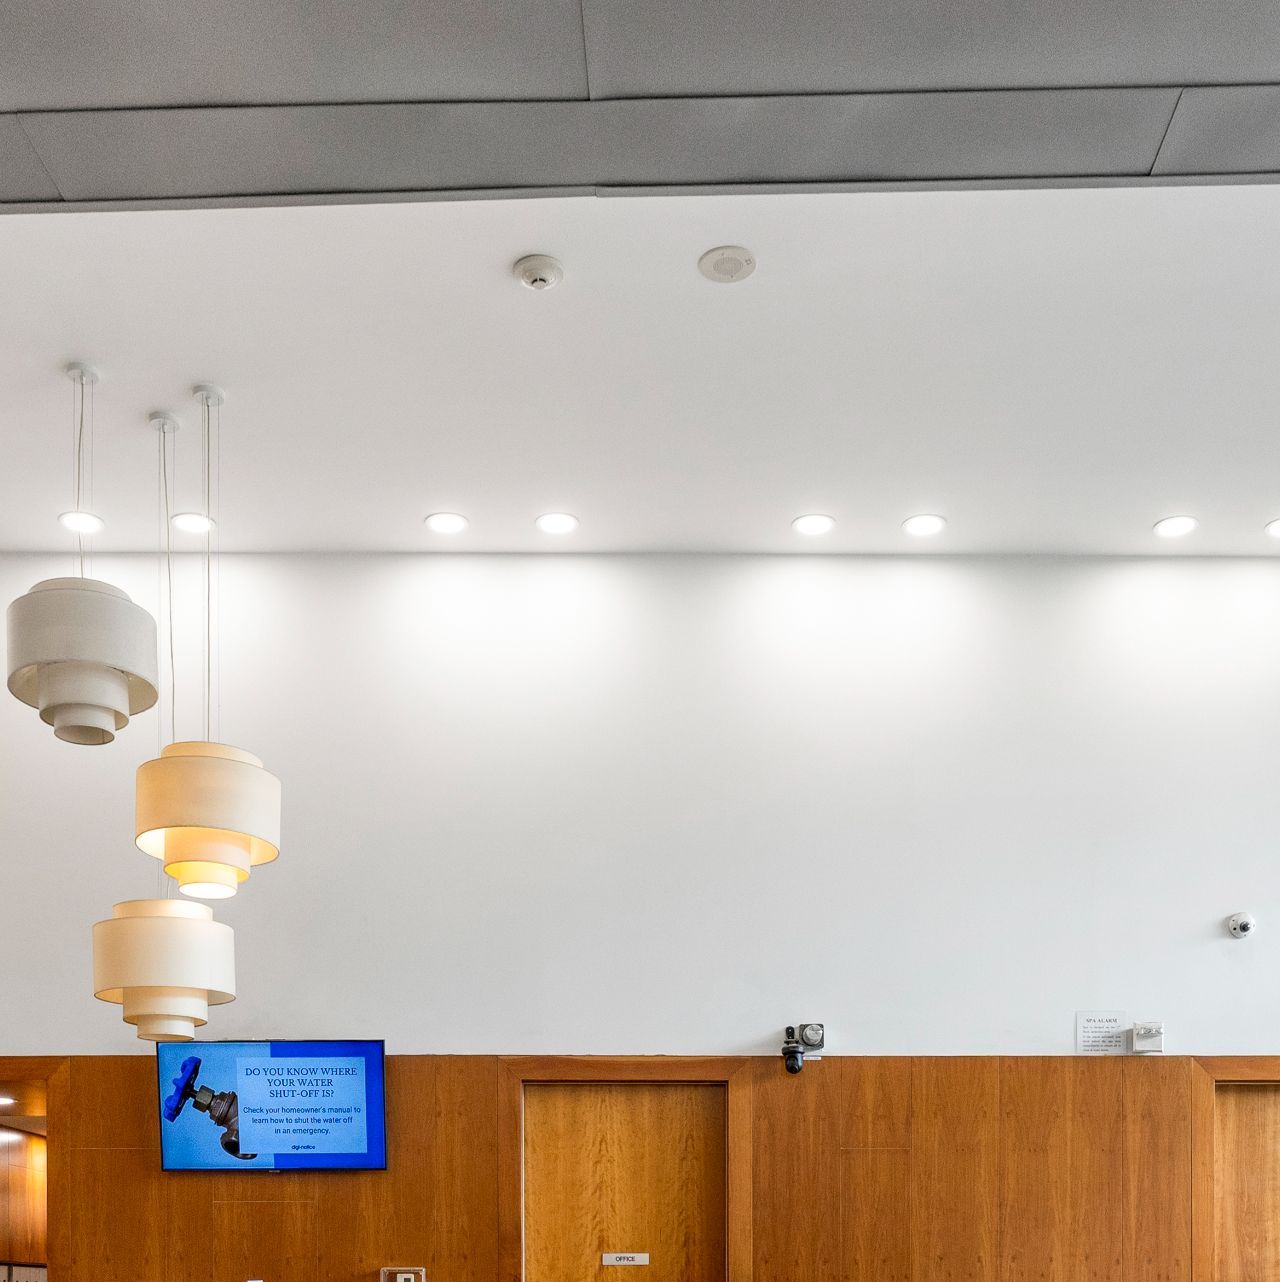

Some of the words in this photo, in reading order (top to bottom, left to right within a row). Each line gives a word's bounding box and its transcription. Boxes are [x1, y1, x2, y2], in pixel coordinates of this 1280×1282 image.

[245, 1067, 260, 1076] DO
[262, 1067, 284, 1076] YOU
[286, 1067, 319, 1076] KNOW
[320, 1067, 358, 1076] WHERE
[267, 1078, 295, 1087] YOUR
[297, 1078, 333, 1087] WATER
[269, 1089, 320, 1098] SHUT-OFF
[322, 1089, 335, 1098] IS?
[243, 1106, 264, 1114] Check
[265, 1108, 280, 1116] your
[281, 1106, 326, 1114] homeowner's
[327, 1106, 352, 1114] manual
[252, 1116, 269, 1124] learn
[270, 1116, 284, 1124] how
[293, 1116, 309, 1124] shut
[310, 1116, 321, 1124] the
[343, 1116, 353, 1124] off
[292, 1128, 331, 1136] emergency.
